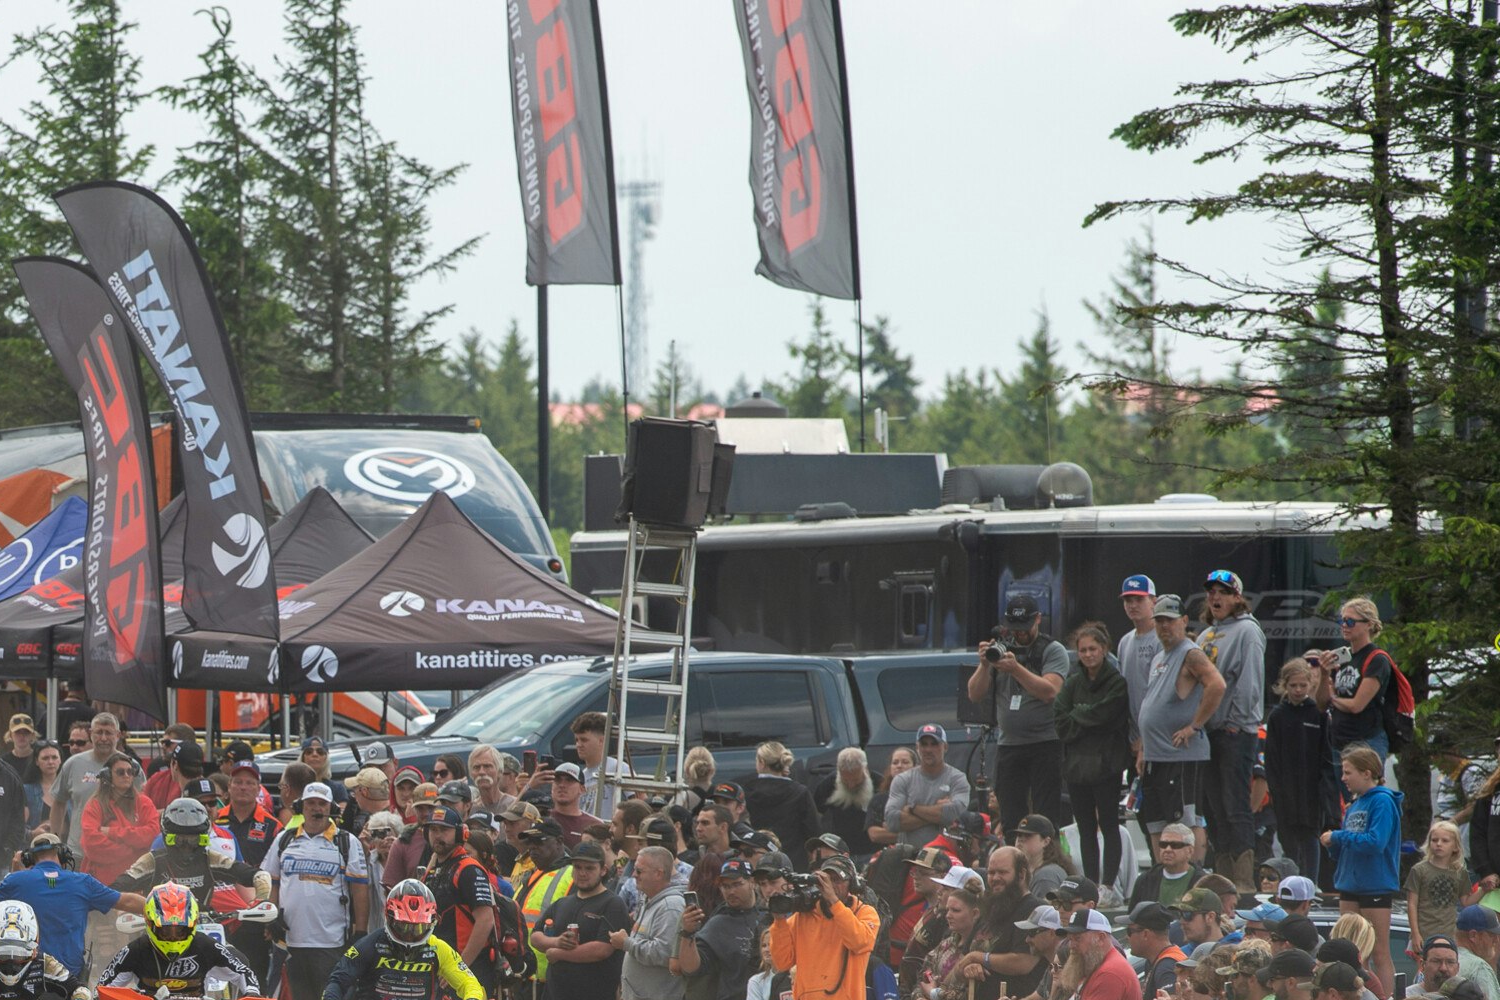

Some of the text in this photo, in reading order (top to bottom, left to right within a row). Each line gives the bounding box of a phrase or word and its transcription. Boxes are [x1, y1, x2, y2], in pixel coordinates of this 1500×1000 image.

[435, 597, 583, 619] KANATI
[466, 613, 501, 622] QUALITY
[501, 611, 562, 621] PERFORMANCE
[16, 642, 42, 654] GBC
[56, 642, 82, 655] GBC
